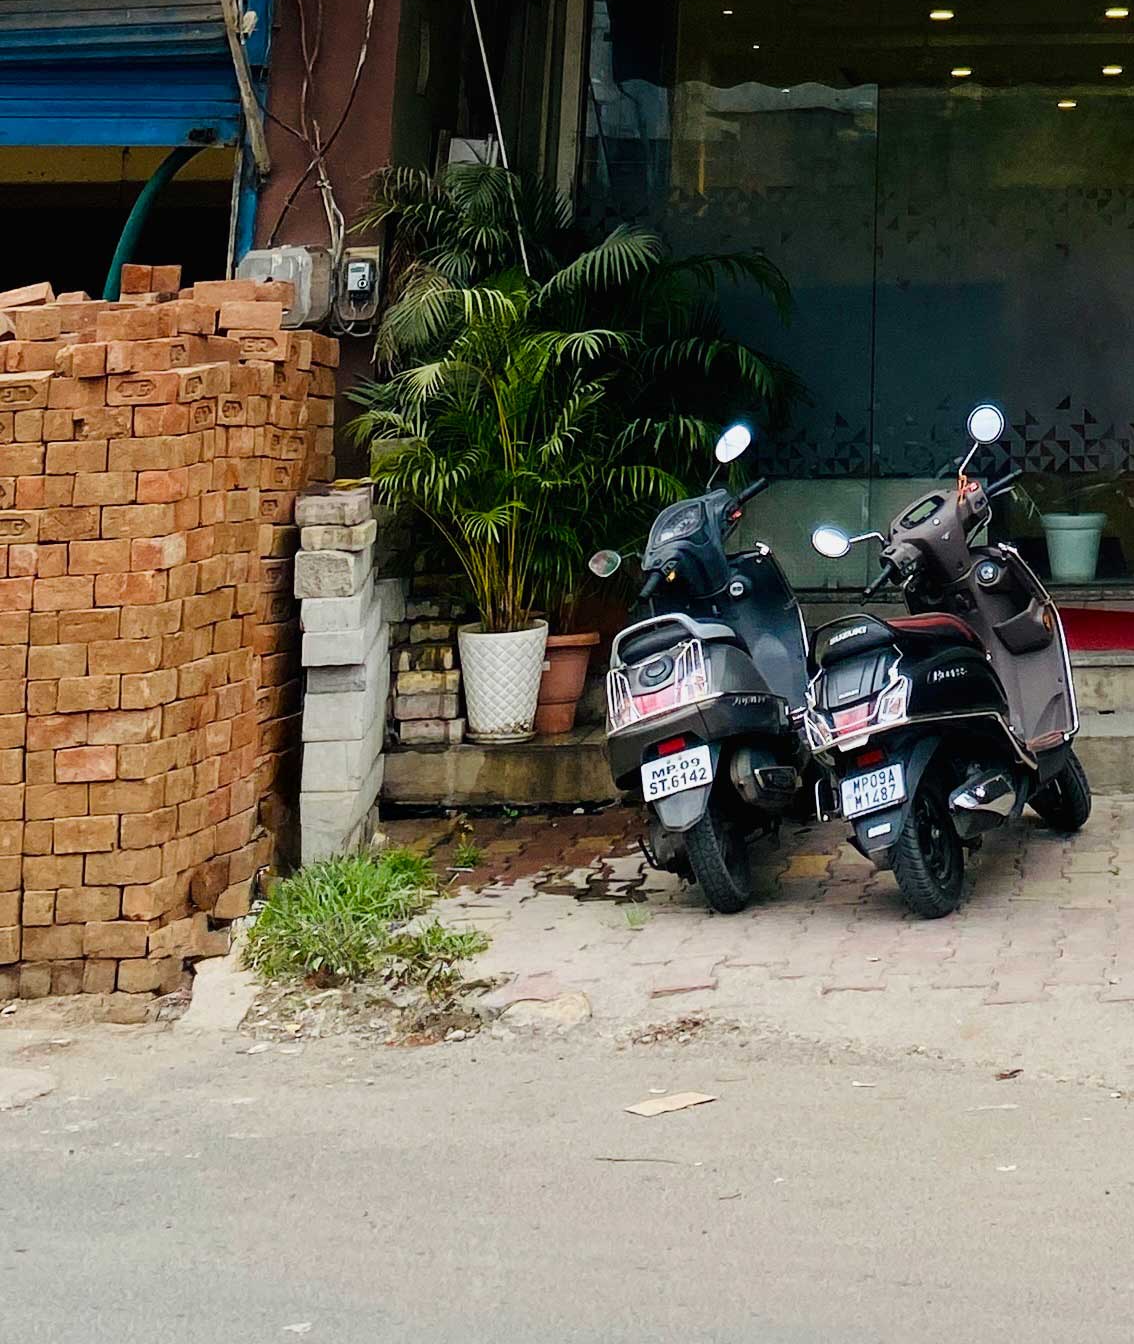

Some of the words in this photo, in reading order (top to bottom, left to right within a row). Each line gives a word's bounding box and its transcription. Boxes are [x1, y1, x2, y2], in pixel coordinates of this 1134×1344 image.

[829, 625, 868, 646] SUZUKI
[853, 772, 896, 794] MP09A
[854, 783, 897, 811] M1487
